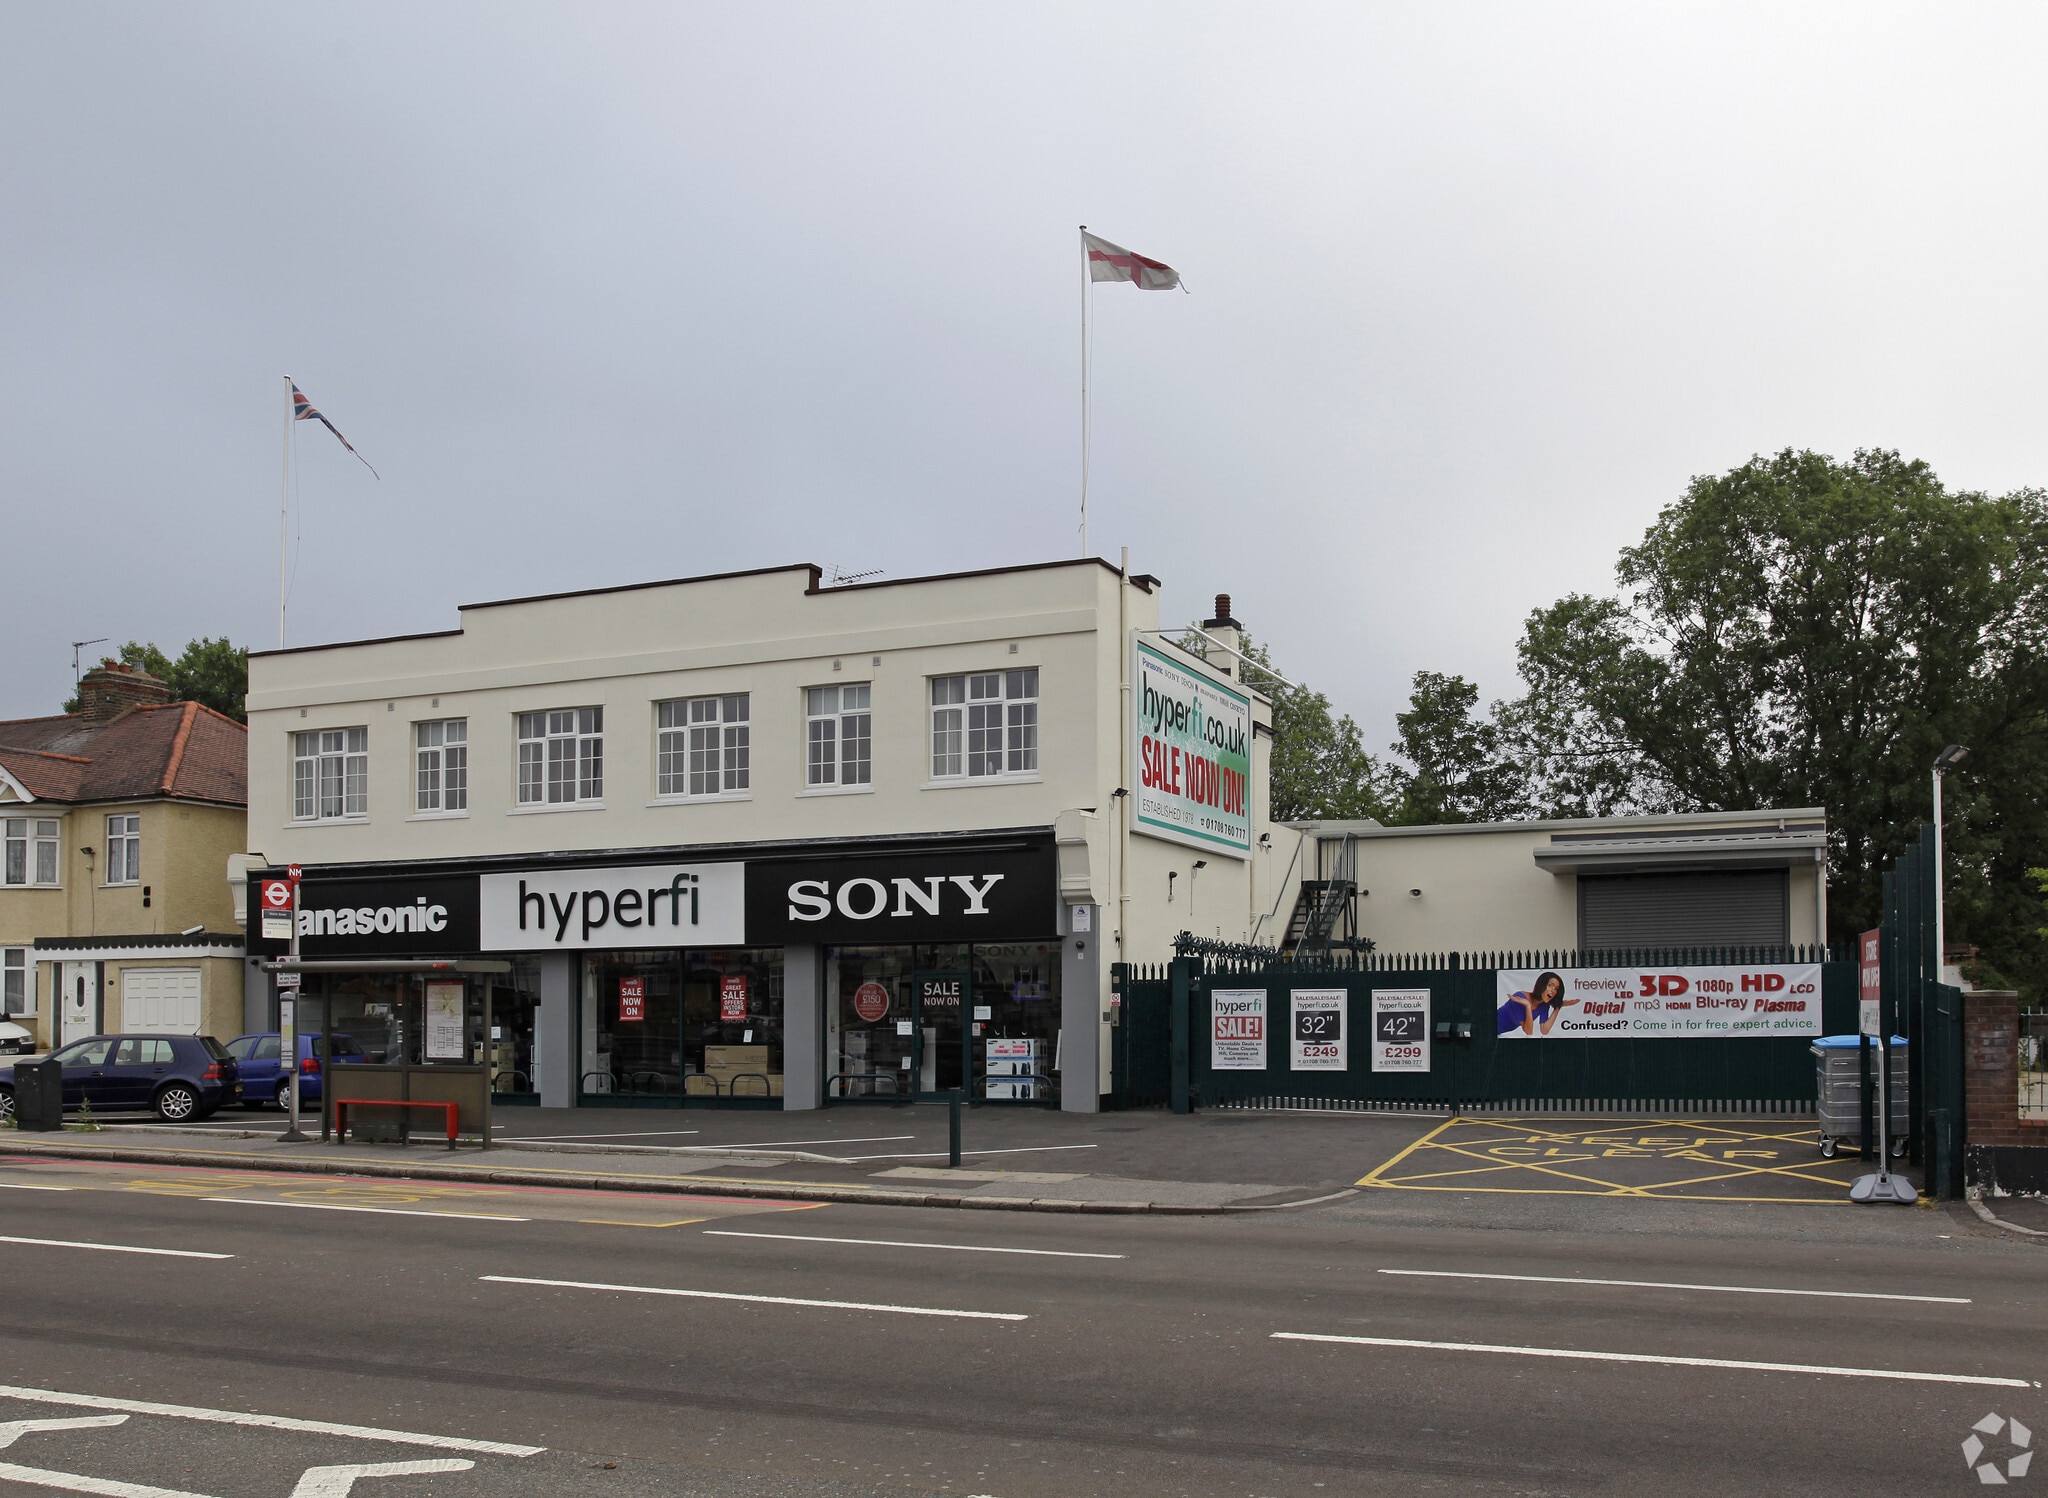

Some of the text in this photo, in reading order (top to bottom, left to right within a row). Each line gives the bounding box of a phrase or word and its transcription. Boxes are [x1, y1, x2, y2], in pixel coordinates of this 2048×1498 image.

[1142, 657, 1164, 674] Panasonic
[1164, 669, 1180, 683] SONY
[1142, 670, 1246, 758] hyperfi.co.uk
[1142, 735, 1245, 818] SALE NOW ON!
[1143, 798, 1181, 820] ESTABLISHED
[1205, 818, 1246, 840] 01708 760 777
[288, 868, 302, 877] NM
[787, 874, 1004, 922] SONY
[518, 873, 699, 942] hyperfi
[299, 896, 447, 936] anasonic
[621, 987, 642, 996] SALE
[924, 982, 960, 995] SALE
[1574, 973, 1815, 997] freeview 3D 1080p HD LCD
[622, 997, 641, 1006] NOW
[722, 990, 745, 1000] SALE
[924, 997, 960, 1006] NOW ON
[1614, 991, 1634, 999] LED
[626, 1007, 638, 1016] ON
[1215, 998, 1262, 1015] hyperfi
[1297, 1001, 1339, 1010] hyperfi.co.uk
[1379, 1001, 1422, 1010] hyperfi.co.uk
[1583, 996, 1806, 1017] Digital mp3 HDMI Blu-ray Plasma
[1217, 1017, 1259, 1038] SALE!
[1561, 1018, 1817, 1031] Confused? Come in for free expert advice.
[1303, 1046, 1339, 1057] £249
[1385, 1047, 1422, 1058] £299
[1525, 1135, 1743, 1146] KEEP
[1488, 1146, 1779, 1159] CLEAR
